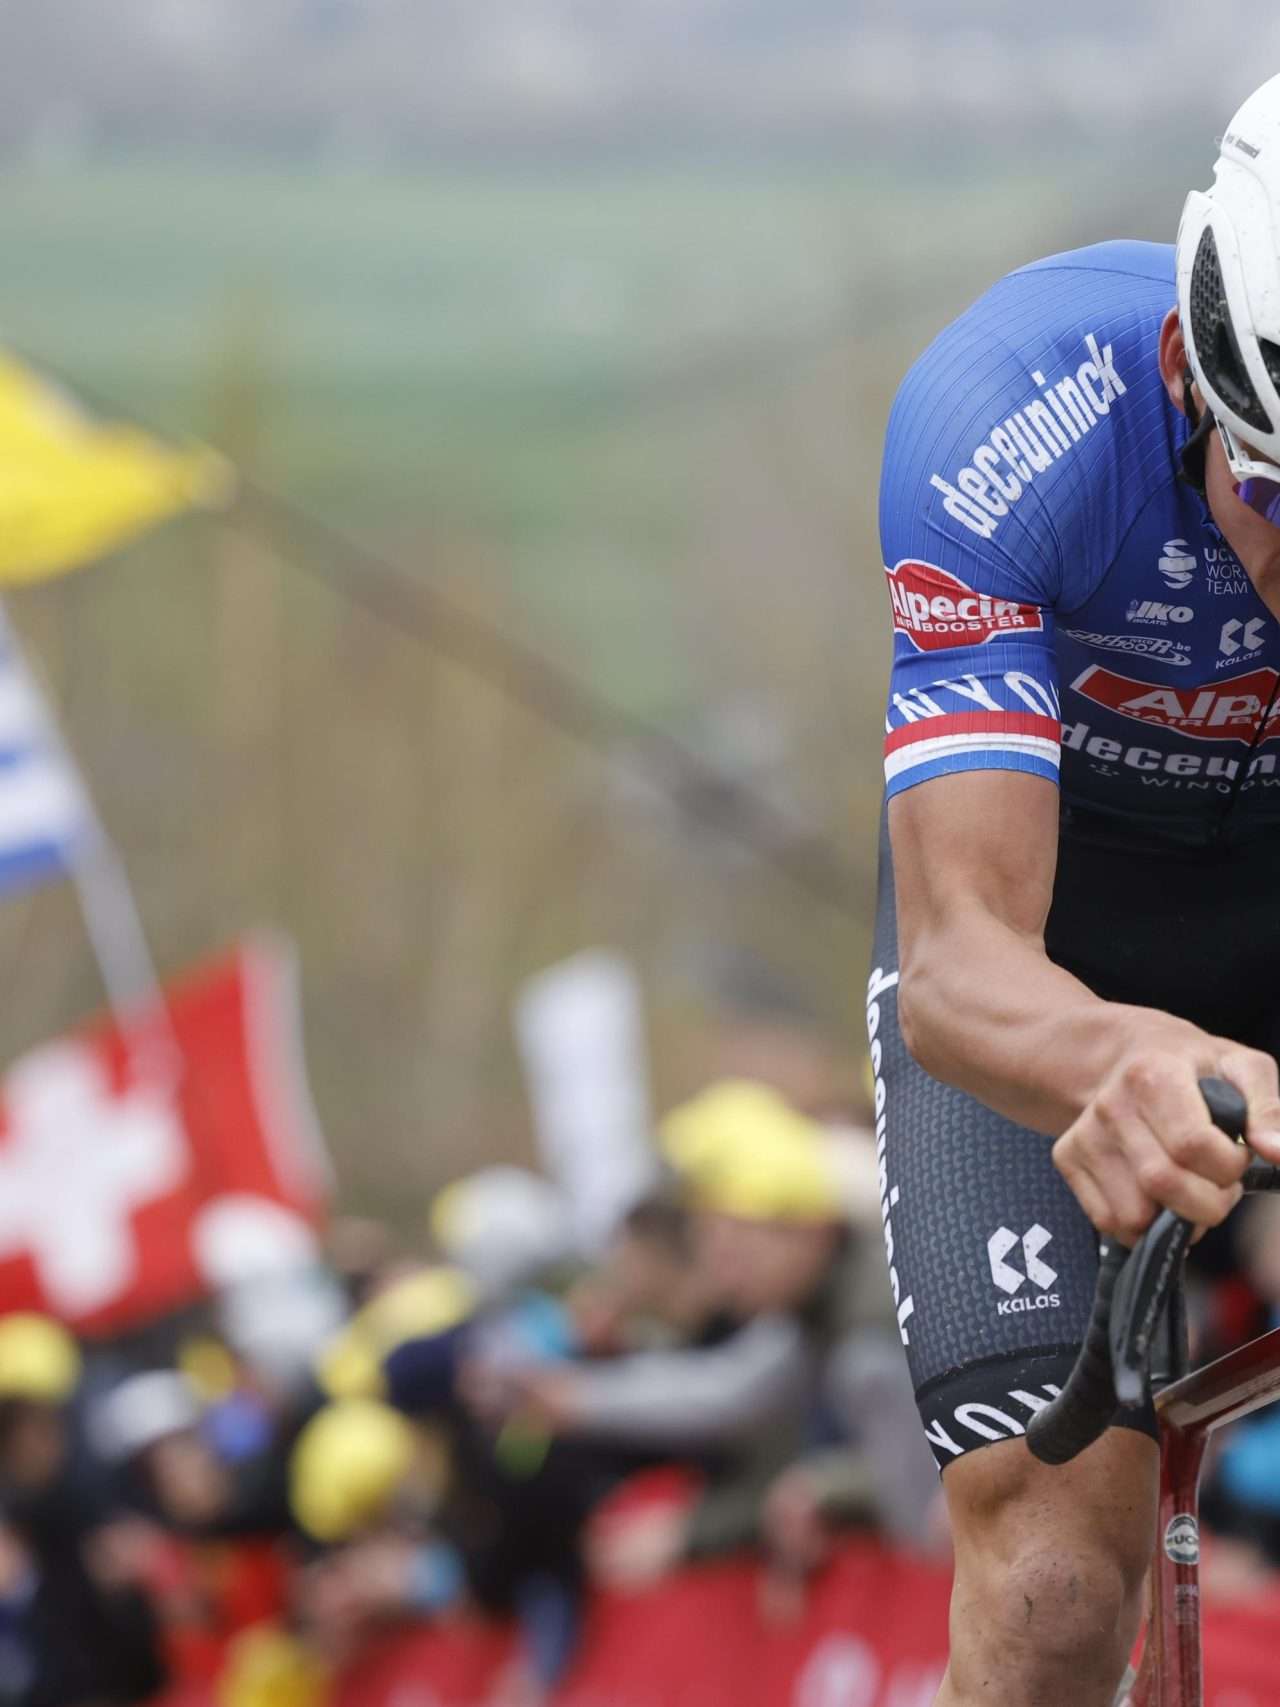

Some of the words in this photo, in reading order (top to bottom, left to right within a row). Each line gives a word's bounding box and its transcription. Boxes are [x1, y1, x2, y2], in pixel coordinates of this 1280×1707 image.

[929, 332, 1127, 539] deceuninck
[1205, 578, 1248, 595] TEAM
[889, 577, 1020, 632] Alpecin
[1136, 600, 1194, 623] IKO
[922, 615, 1024, 633] BOOSTER
